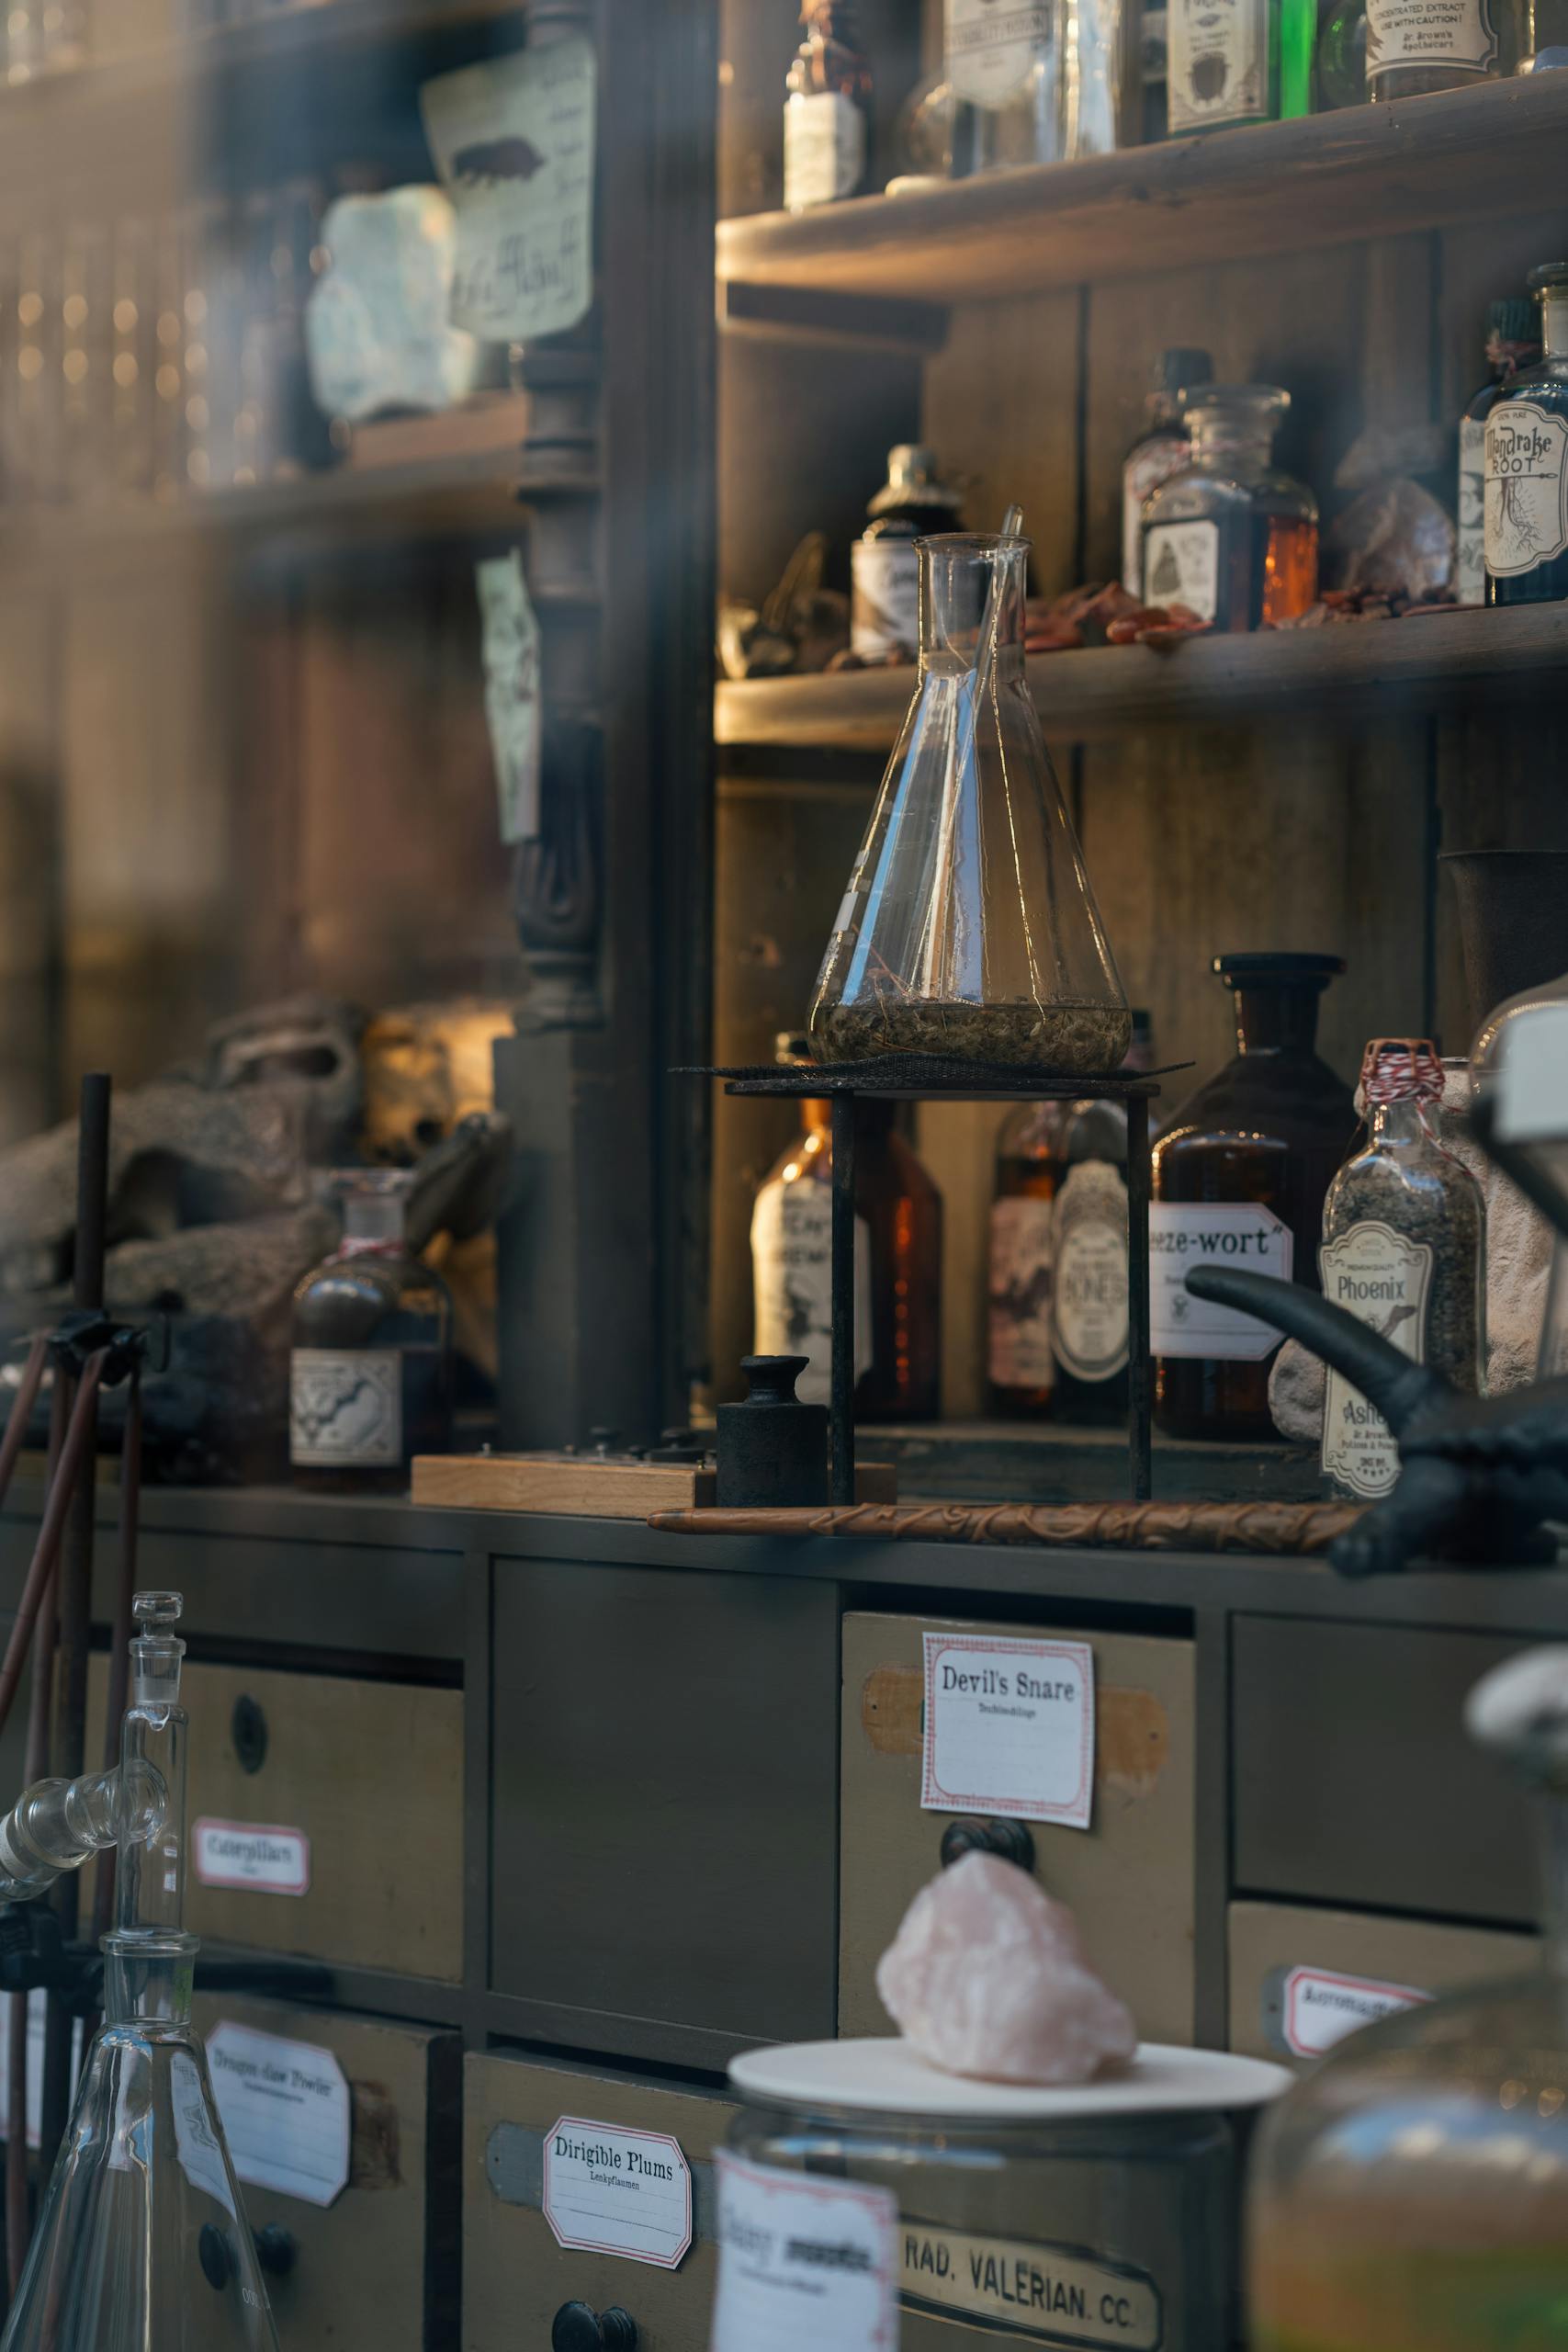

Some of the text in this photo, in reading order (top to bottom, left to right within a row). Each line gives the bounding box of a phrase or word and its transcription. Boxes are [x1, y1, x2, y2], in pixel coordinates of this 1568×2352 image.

[1426, 3, 1467, 12] EXTRACT
[1394, 19, 1416, 28] WITH
[1492, 458, 1536, 475] ROOT
[1337, 1275, 1405, 1301] Phoenix
[942, 1665, 1075, 1702] Devil's Snare
[554, 2135, 622, 2169] Dirigible
[627, 2151, 673, 2182] Plums
[590, 2170, 640, 2191] Lenkpflaumen
